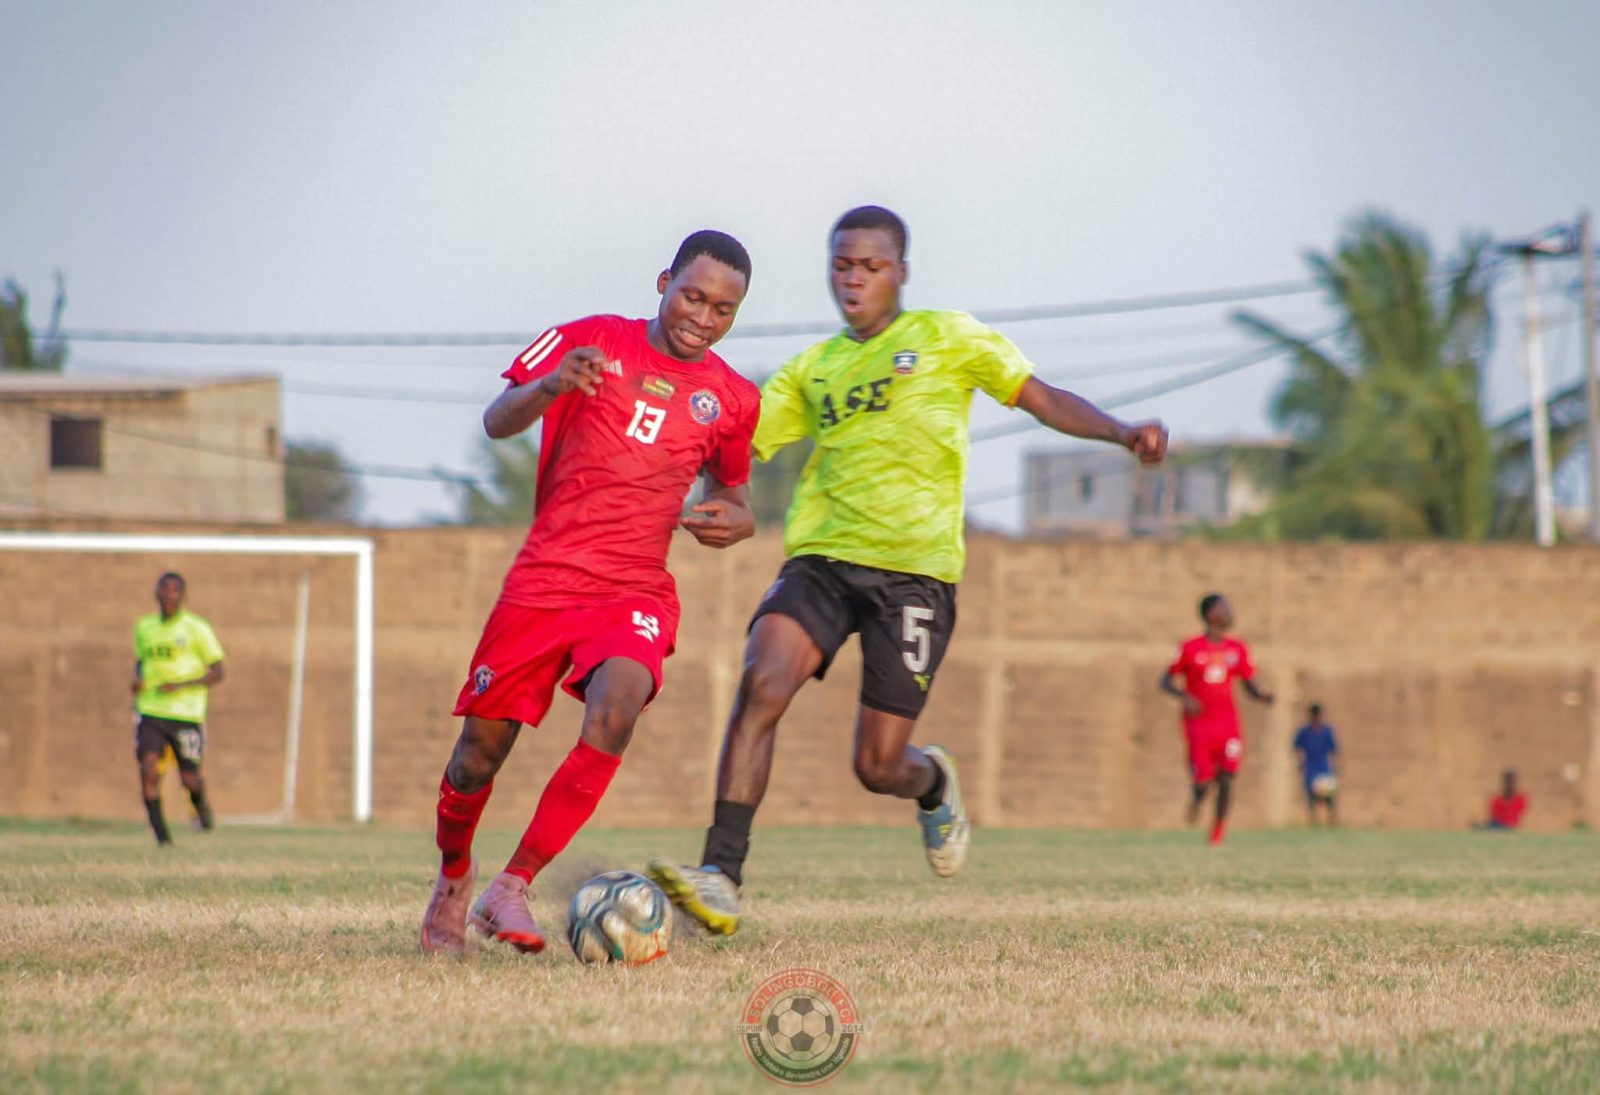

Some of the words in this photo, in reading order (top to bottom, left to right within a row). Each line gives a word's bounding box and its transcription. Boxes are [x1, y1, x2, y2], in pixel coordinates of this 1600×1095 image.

[626, 399, 667, 445] 13
[819, 377, 893, 428] ASE
[901, 605, 935, 674] 5
